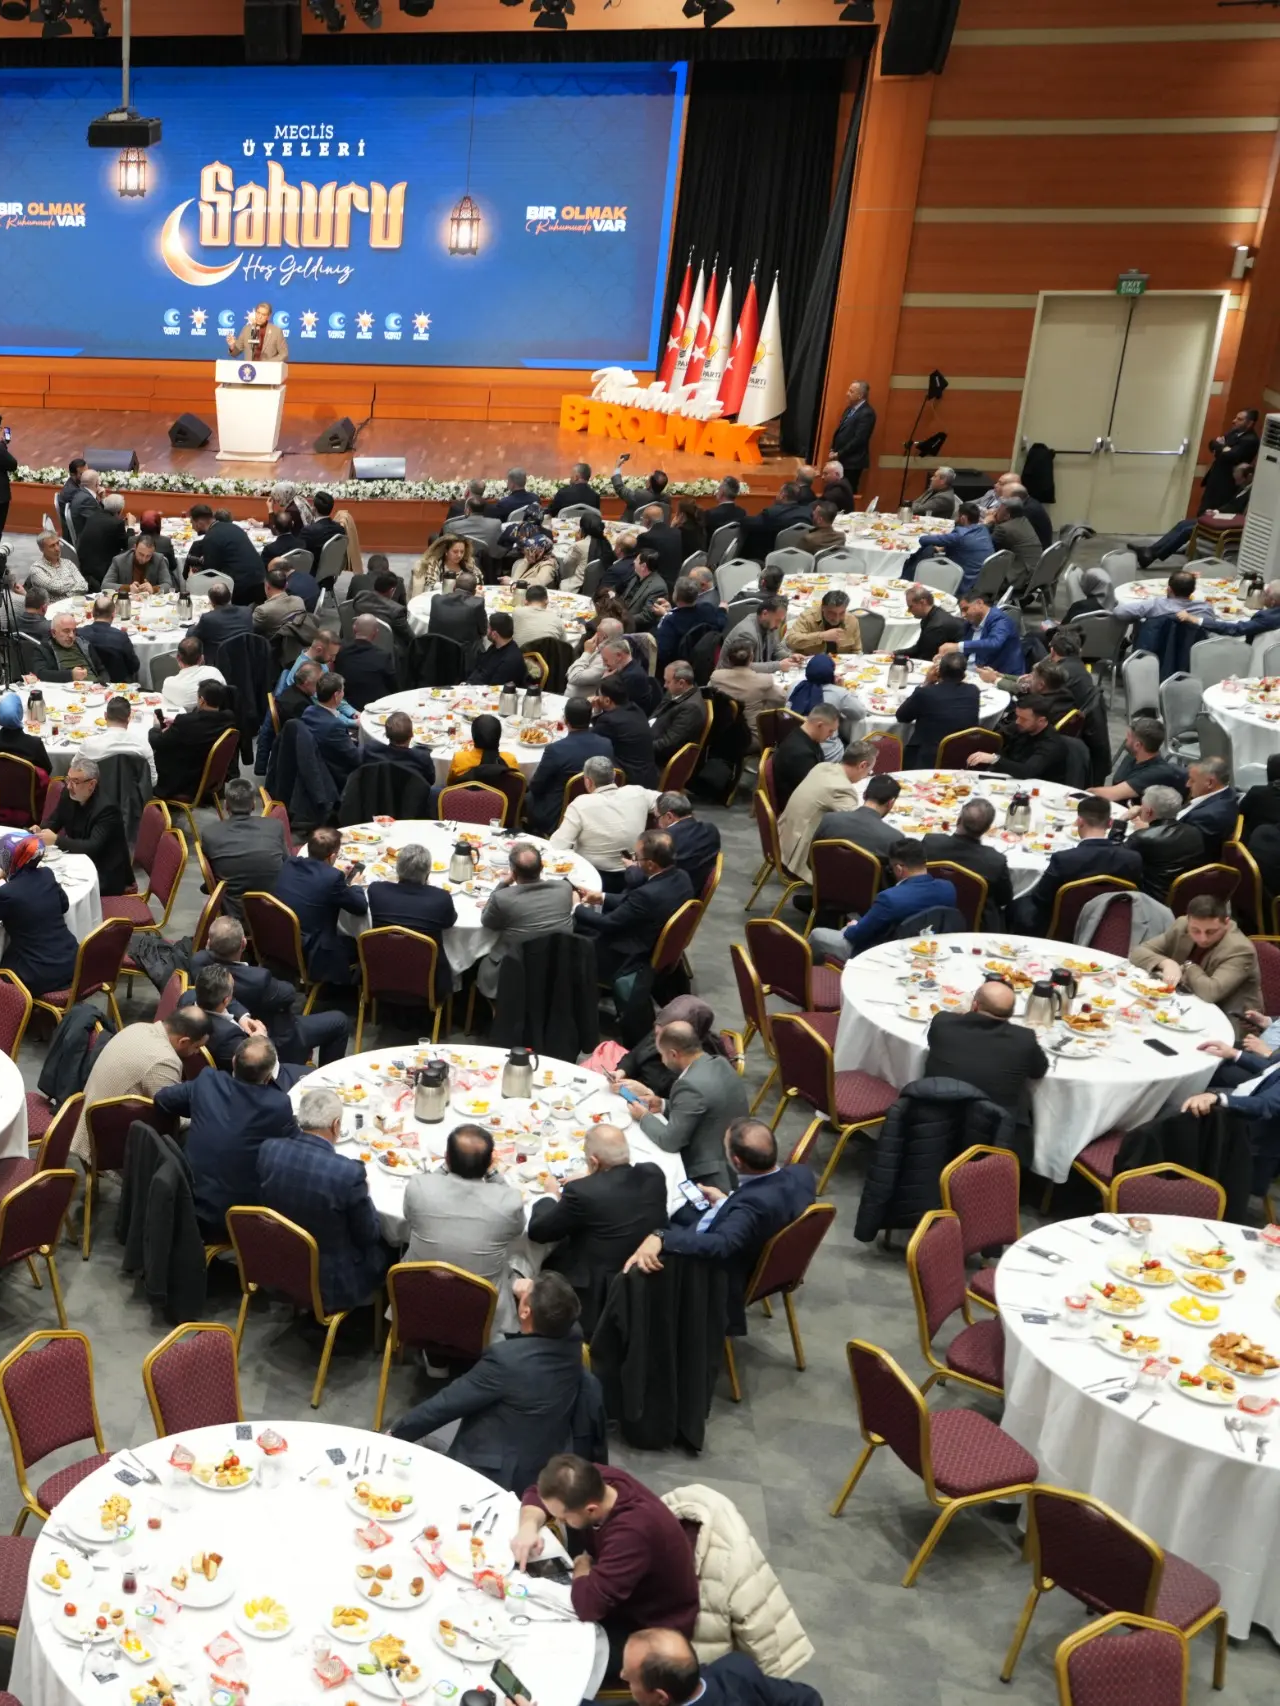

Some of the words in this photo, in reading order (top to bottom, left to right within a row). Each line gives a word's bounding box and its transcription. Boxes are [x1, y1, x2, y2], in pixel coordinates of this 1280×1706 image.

[274, 122, 334, 140] MECLİS
[243, 139, 366, 157] ÜYELERİ
[27, 202, 86, 216] OLMAK
[198, 160, 408, 249] Sahuru
[561, 205, 628, 220] OLMAK
[55, 215, 86, 227] VAR
[592, 219, 627, 232] VAR
[1121, 280, 1142, 289] EXIT
